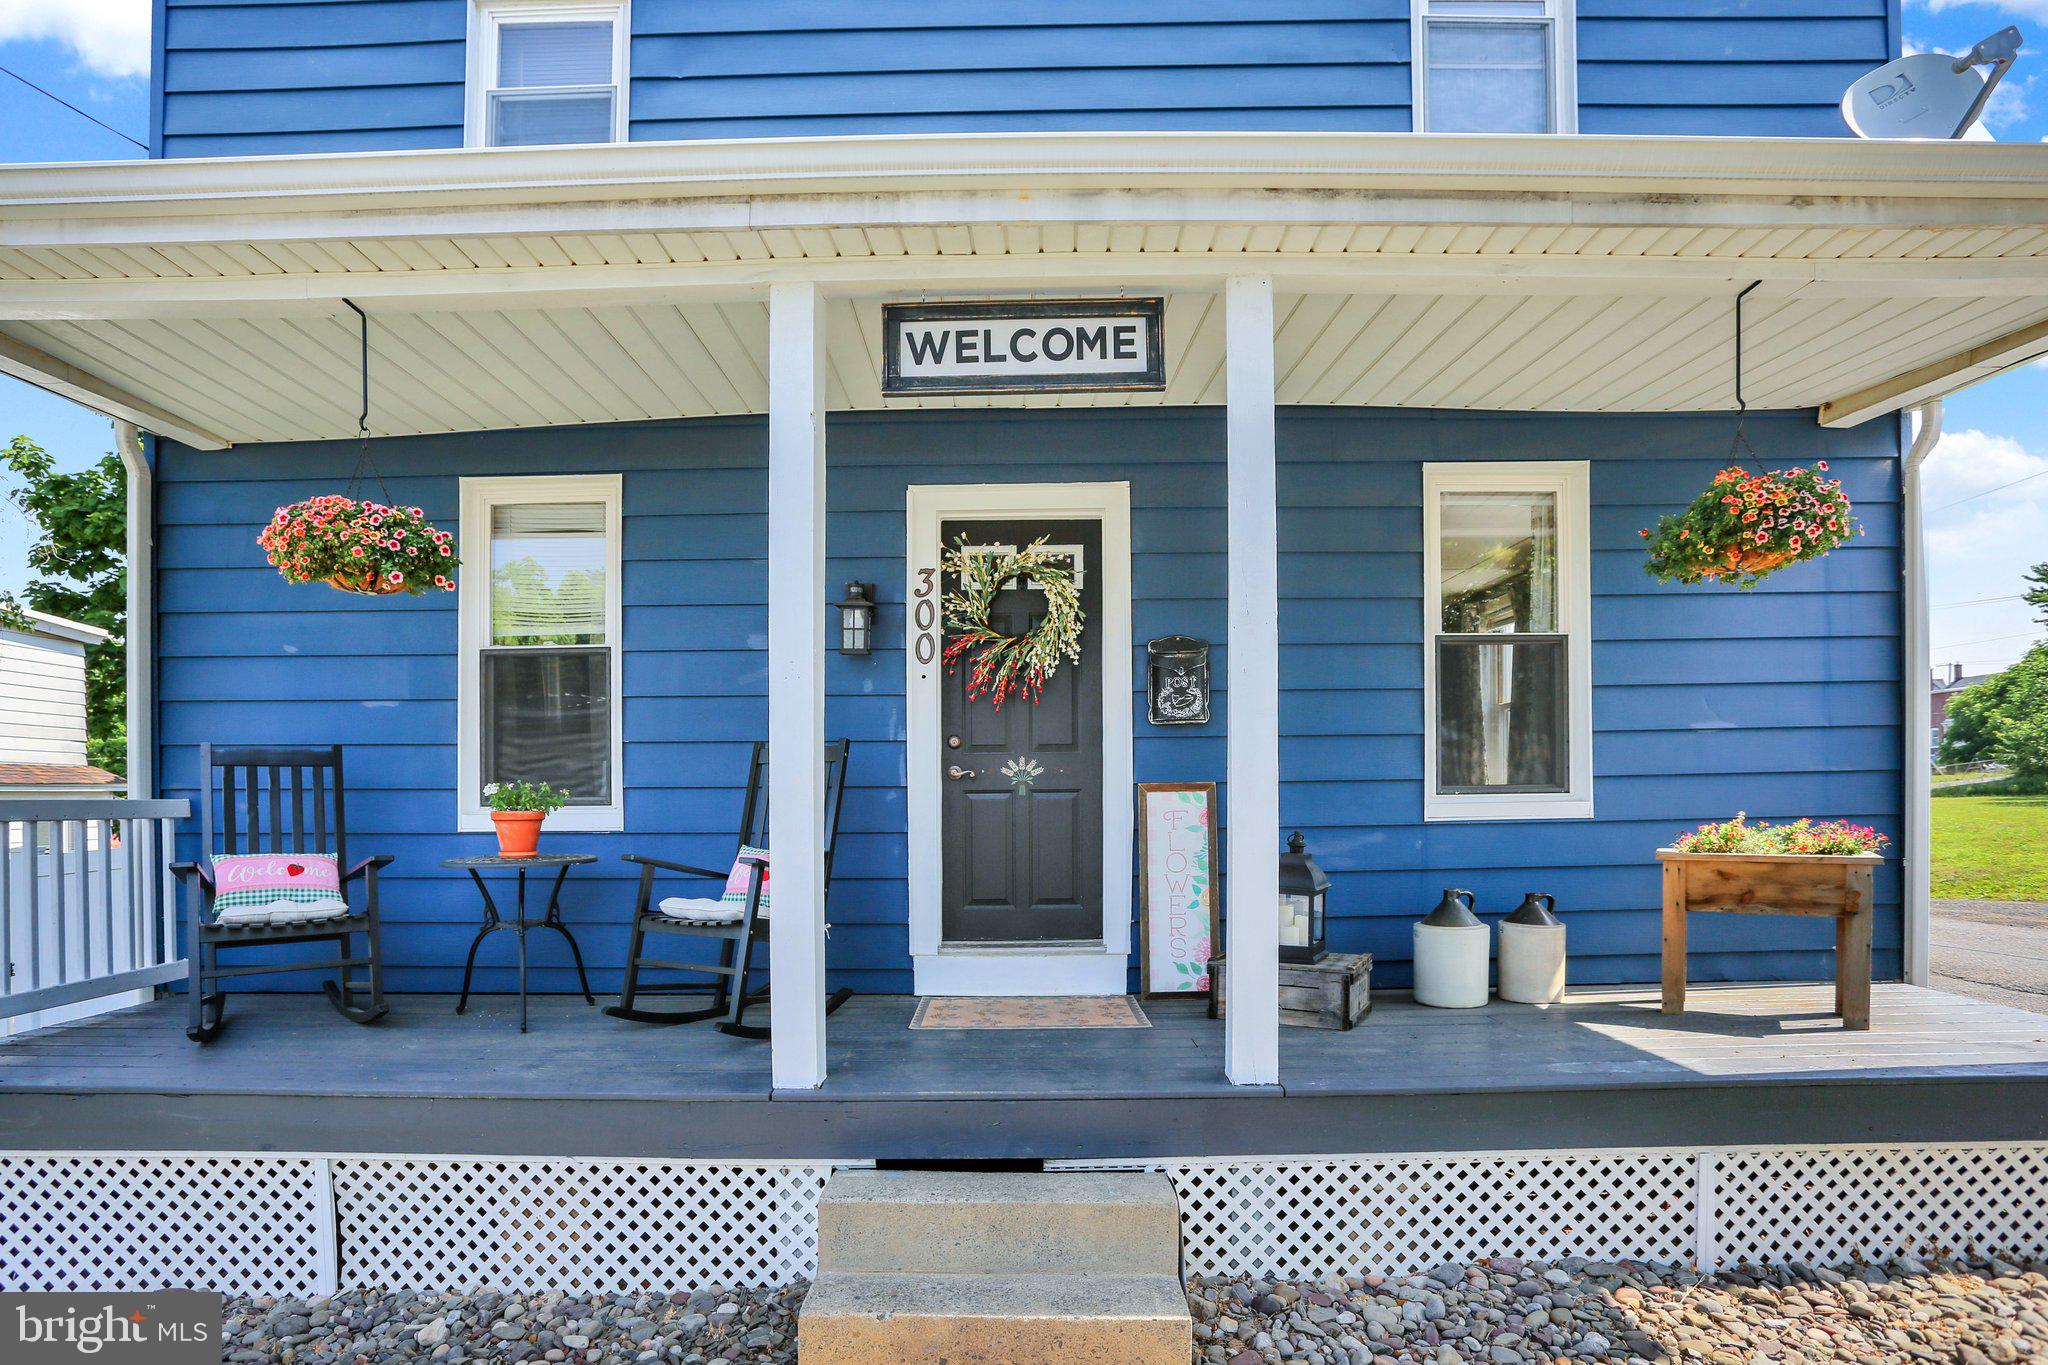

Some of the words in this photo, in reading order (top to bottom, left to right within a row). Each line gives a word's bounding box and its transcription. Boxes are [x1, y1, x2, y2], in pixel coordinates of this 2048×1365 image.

[905, 325, 1138, 366] WELCOME
[914, 567, 936, 665] 300
[1164, 675, 1197, 688] POST
[1163, 810, 1189, 959] FLOWERS
